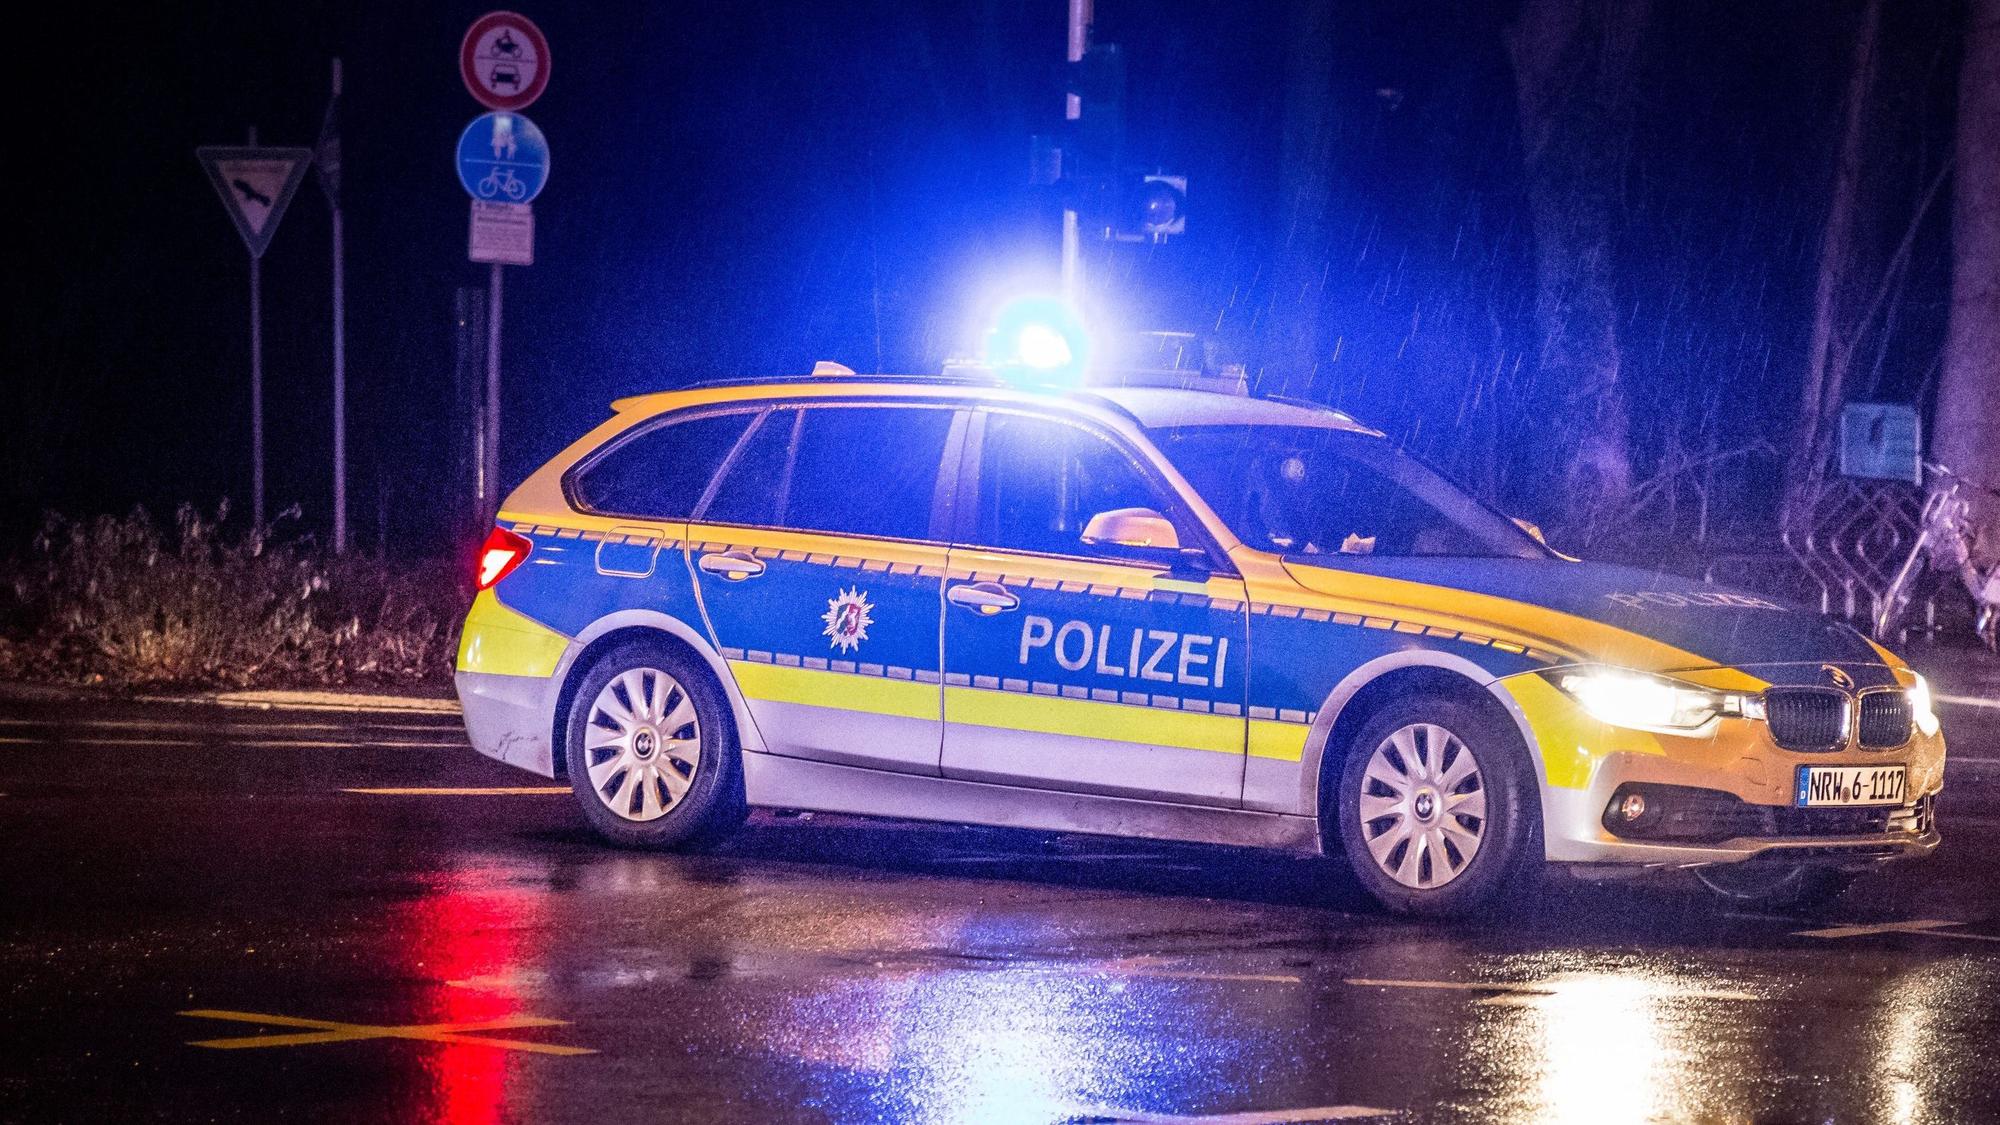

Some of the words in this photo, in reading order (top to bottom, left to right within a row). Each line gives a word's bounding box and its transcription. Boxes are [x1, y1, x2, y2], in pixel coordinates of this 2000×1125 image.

[1019, 615, 1229, 688] POLIZEI
[1809, 772, 1844, 801] NRW
[1852, 770, 1904, 801] 6-1117
